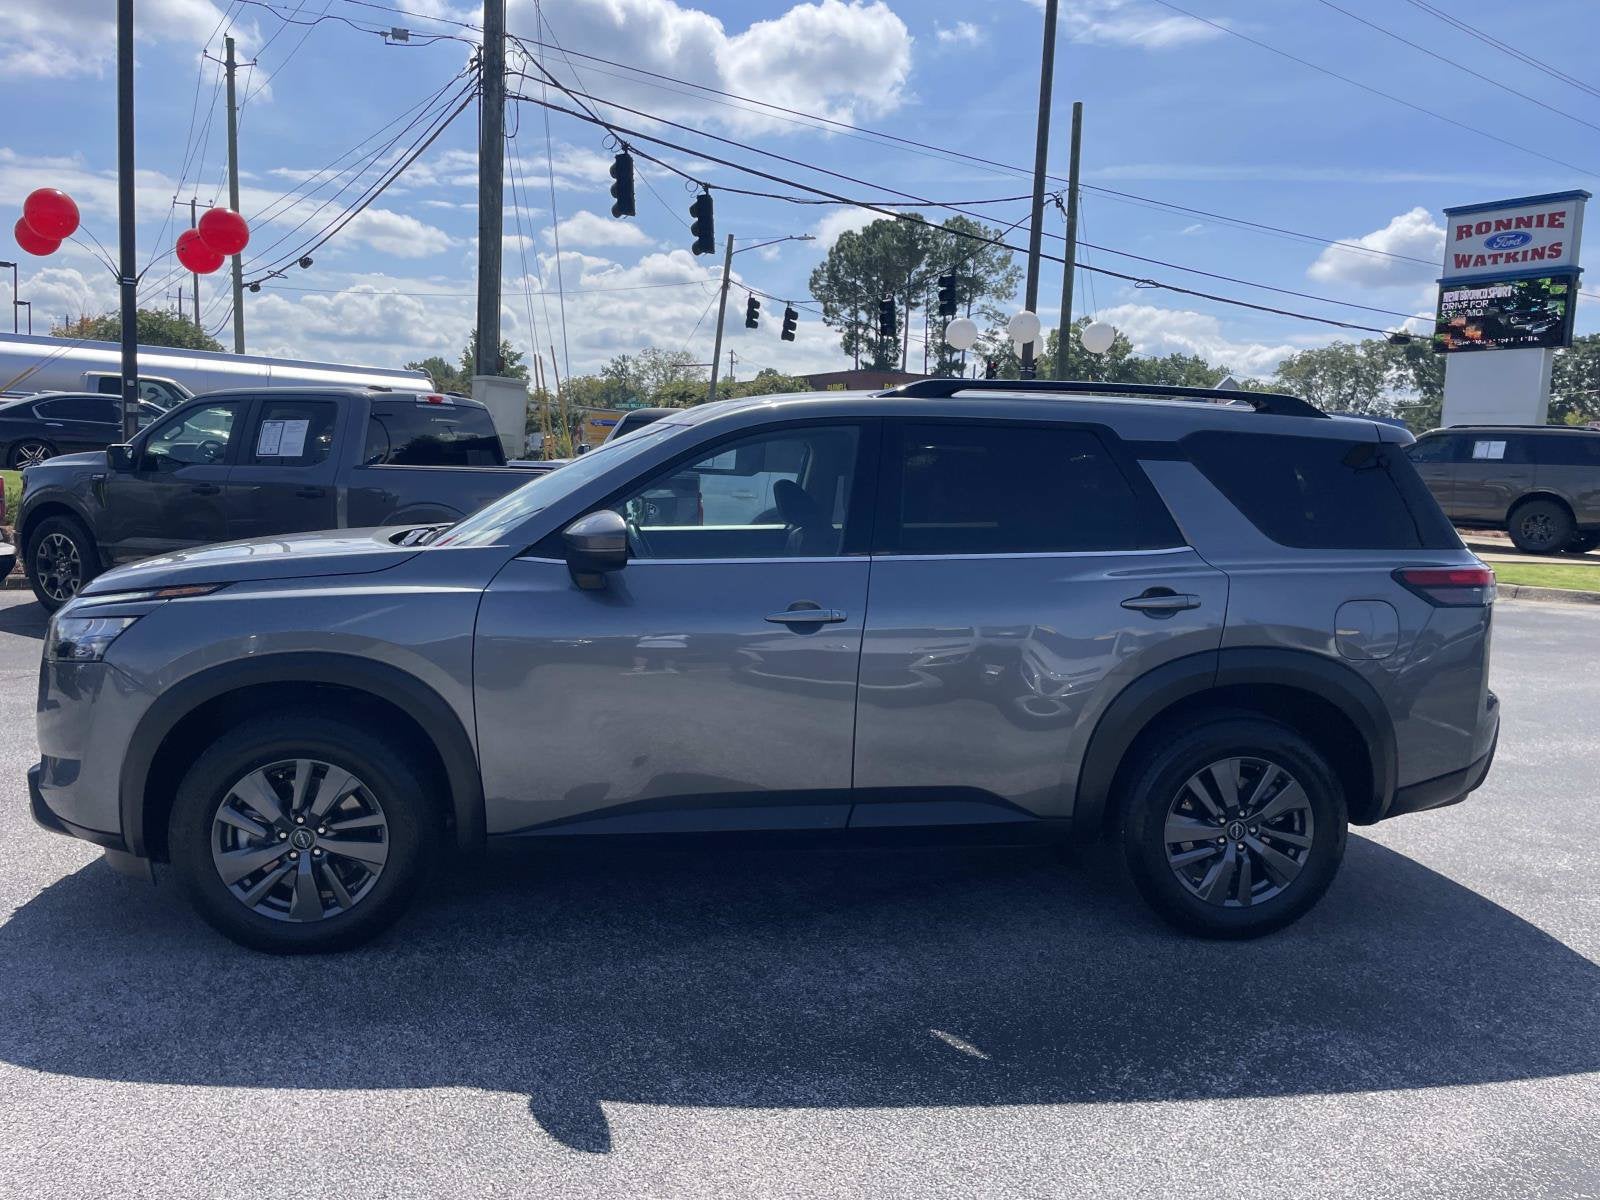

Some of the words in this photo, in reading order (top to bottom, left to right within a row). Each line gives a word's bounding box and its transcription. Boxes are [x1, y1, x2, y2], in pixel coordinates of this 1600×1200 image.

[1456, 211, 1566, 241] RONNIE
[1493, 235, 1523, 248] Ford
[1454, 242, 1563, 269] WATKINS
[1488, 285, 1513, 298] SPORT
